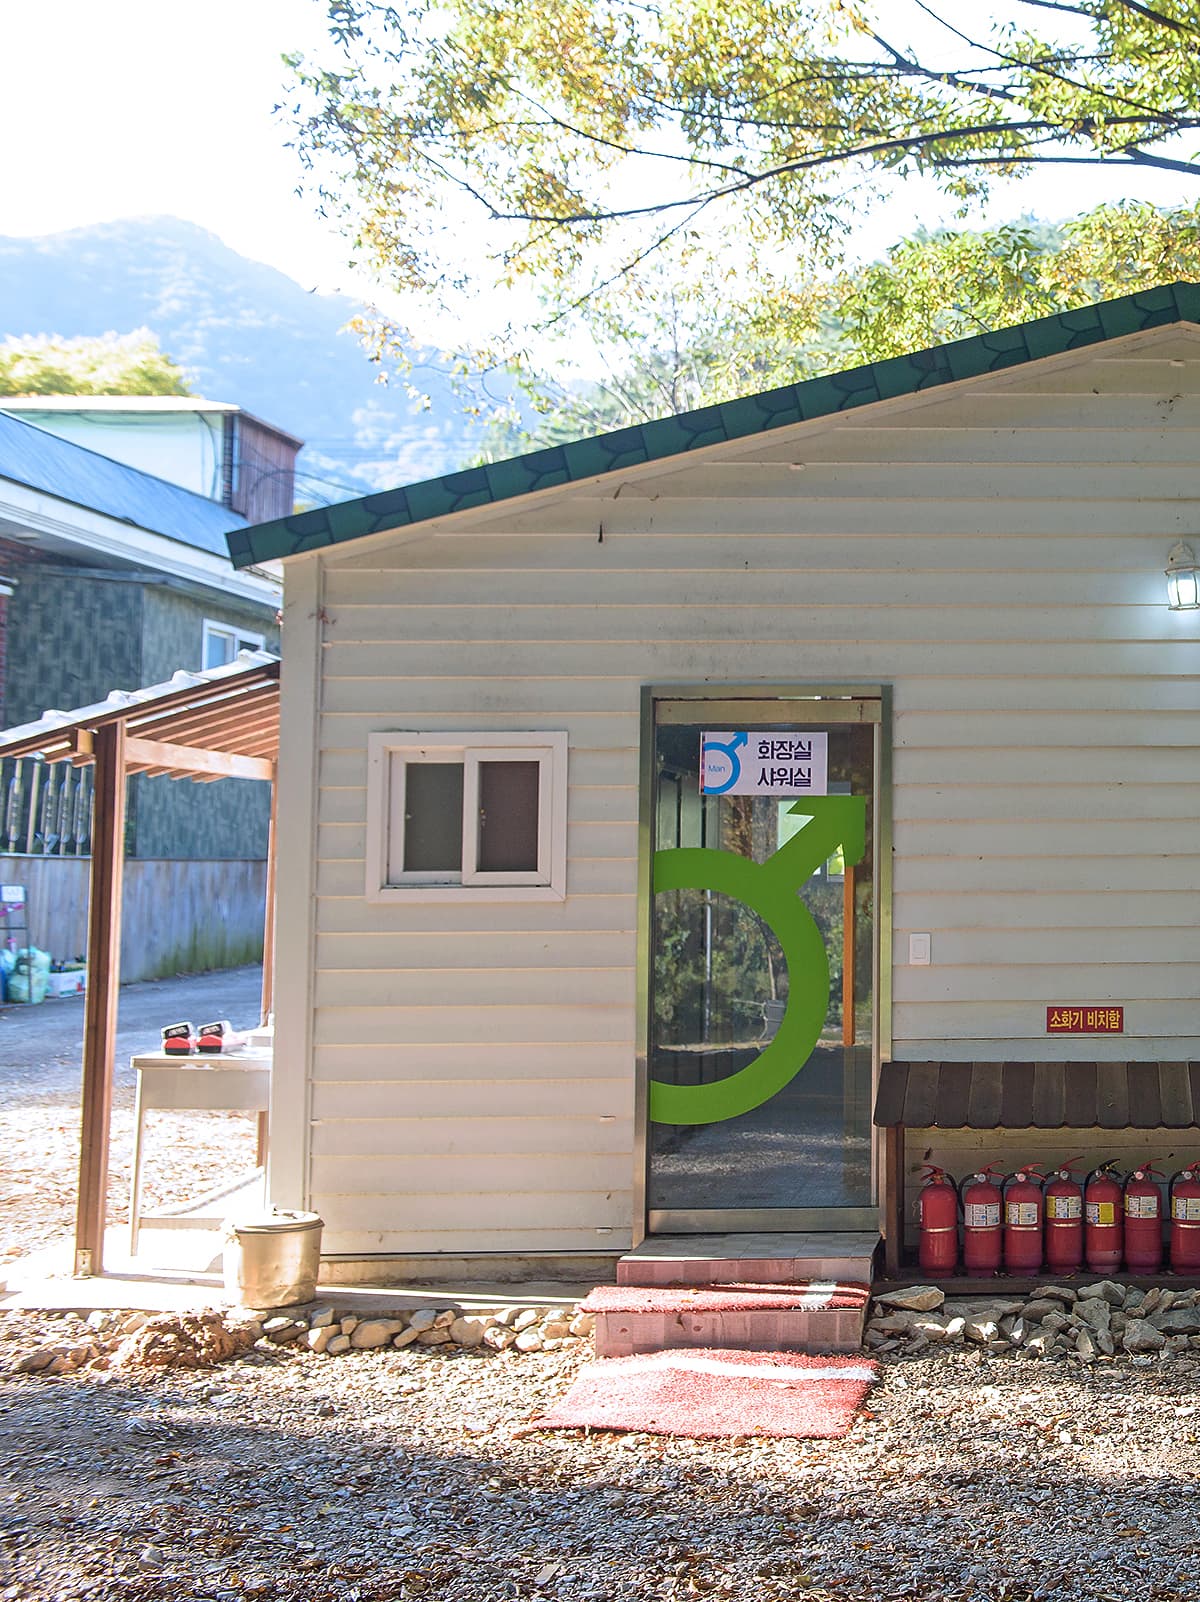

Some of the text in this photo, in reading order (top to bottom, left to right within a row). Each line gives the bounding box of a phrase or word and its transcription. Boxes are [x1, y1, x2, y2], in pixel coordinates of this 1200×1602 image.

[757, 739, 812, 761] 화장실
[708, 765, 726, 773] Man
[757, 767, 812, 787] 샤워실
[1050, 1010, 1121, 1030] 소화기 비치함
